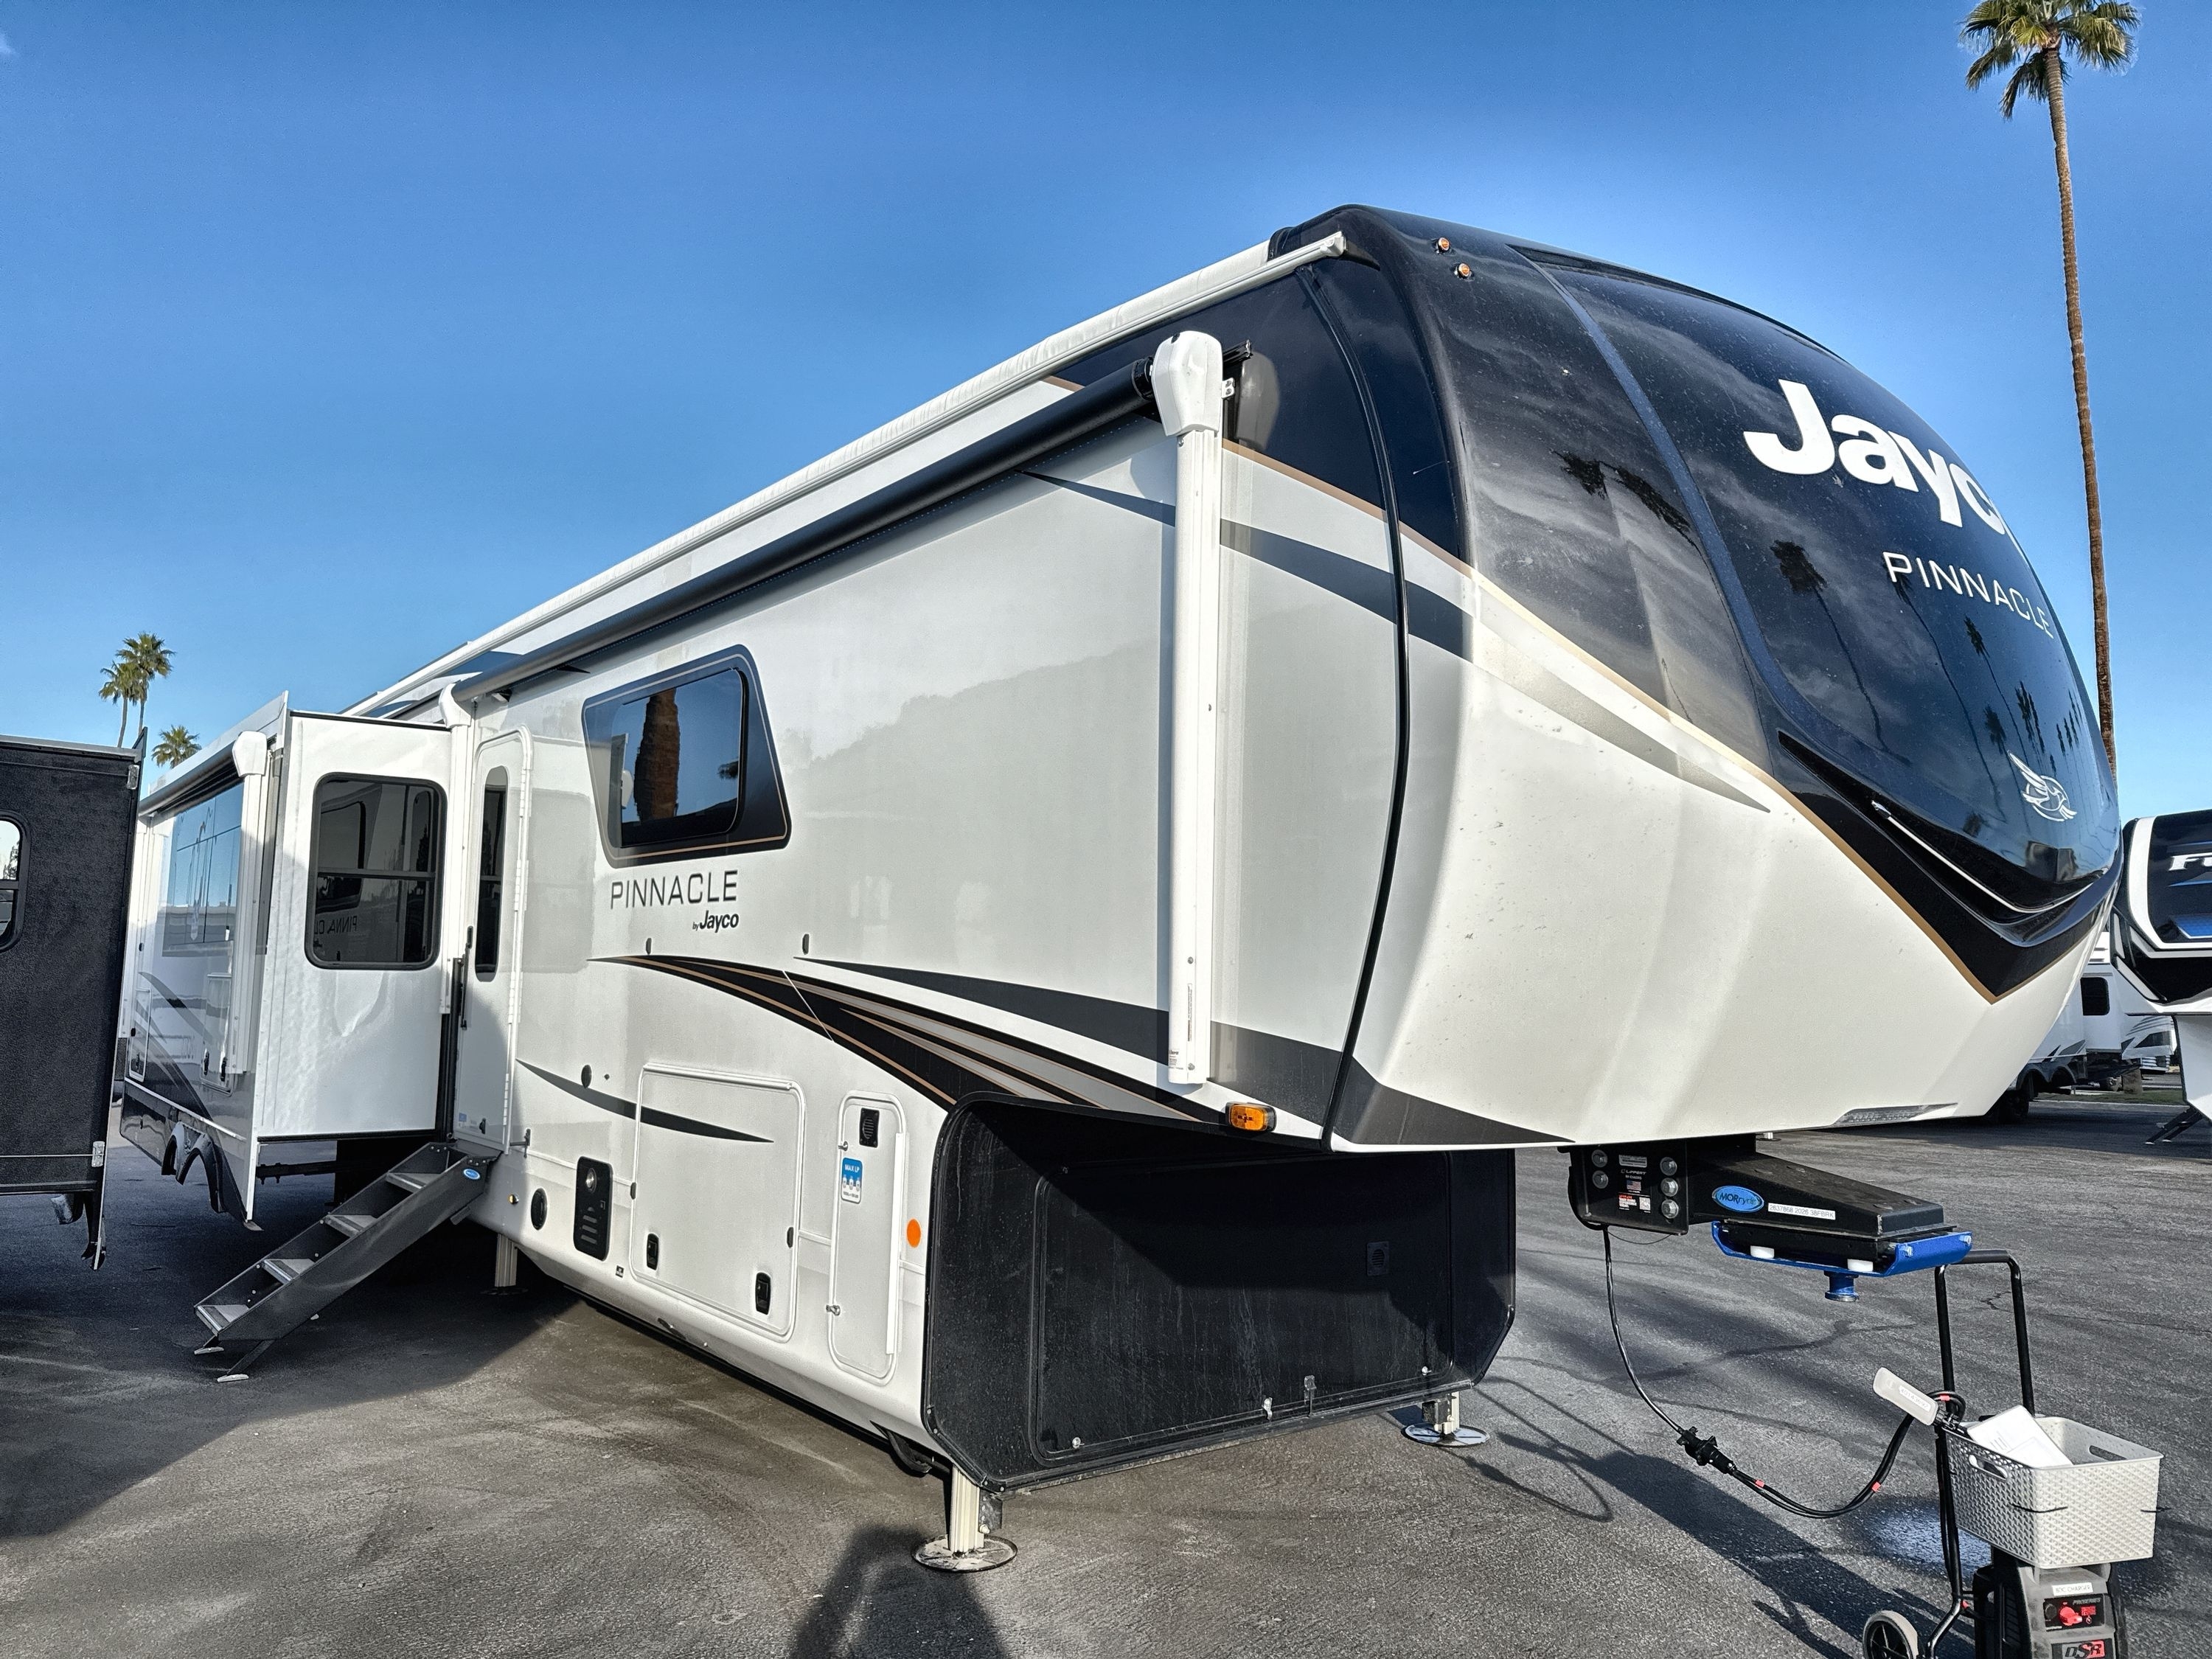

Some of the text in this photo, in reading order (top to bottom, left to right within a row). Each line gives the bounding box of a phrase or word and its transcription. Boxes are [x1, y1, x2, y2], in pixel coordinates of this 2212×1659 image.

[1743, 378, 2022, 546] Jayc
[1882, 552, 2054, 639] PINNACLE
[611, 870, 738, 909] PINNACLE
[692, 910, 740, 933] by Jayco
[844, 1164, 854, 1172] MAX
